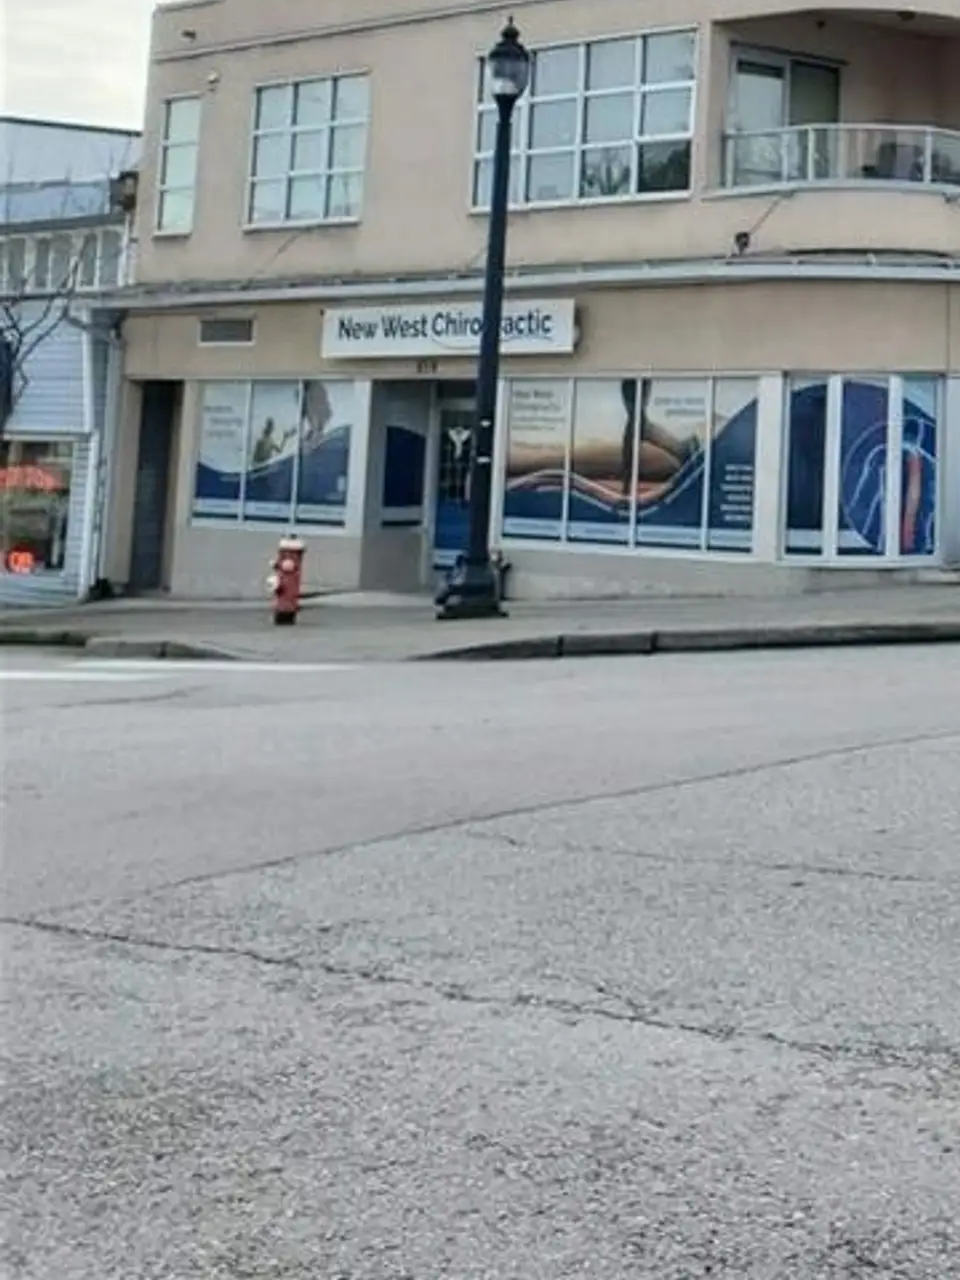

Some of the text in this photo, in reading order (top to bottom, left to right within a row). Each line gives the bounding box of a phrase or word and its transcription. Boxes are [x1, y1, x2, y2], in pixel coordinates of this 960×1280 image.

[338, 308, 552, 341] New West Chiroactic
